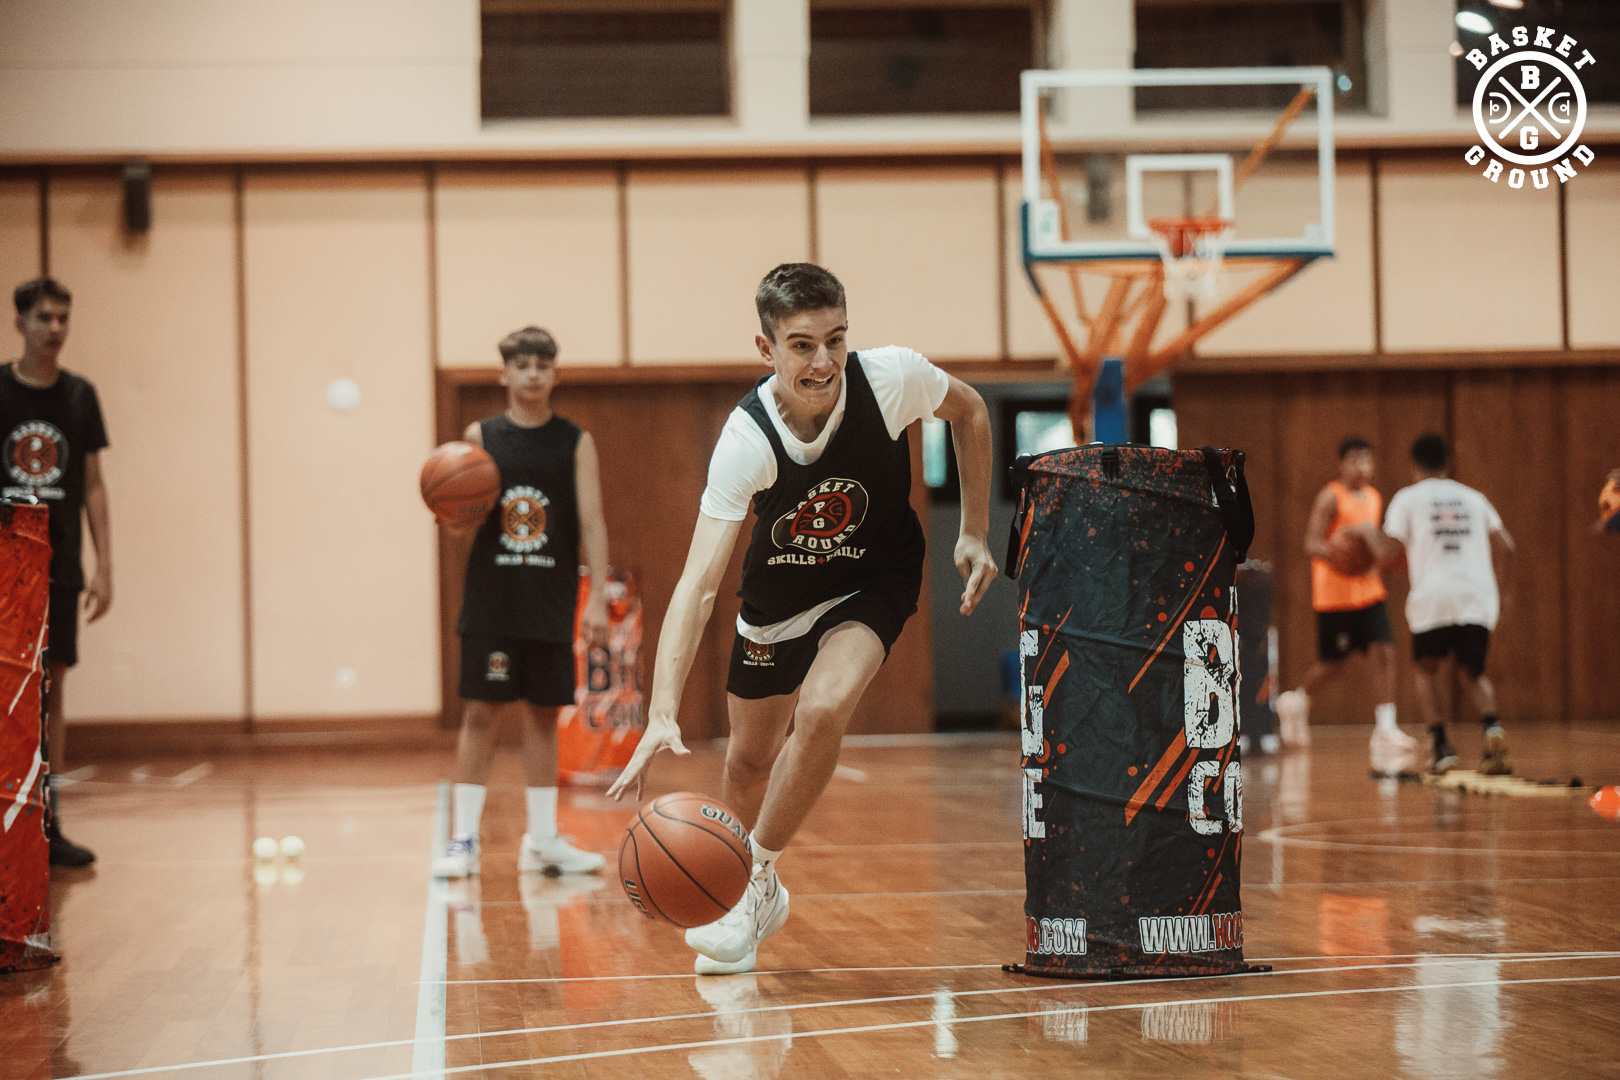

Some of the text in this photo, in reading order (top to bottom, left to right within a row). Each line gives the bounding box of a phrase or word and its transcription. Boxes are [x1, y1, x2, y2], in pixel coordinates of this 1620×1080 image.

[813, 518, 825, 529] G
[793, 525, 856, 550] ROUND
[1183, 619, 1242, 749] B
